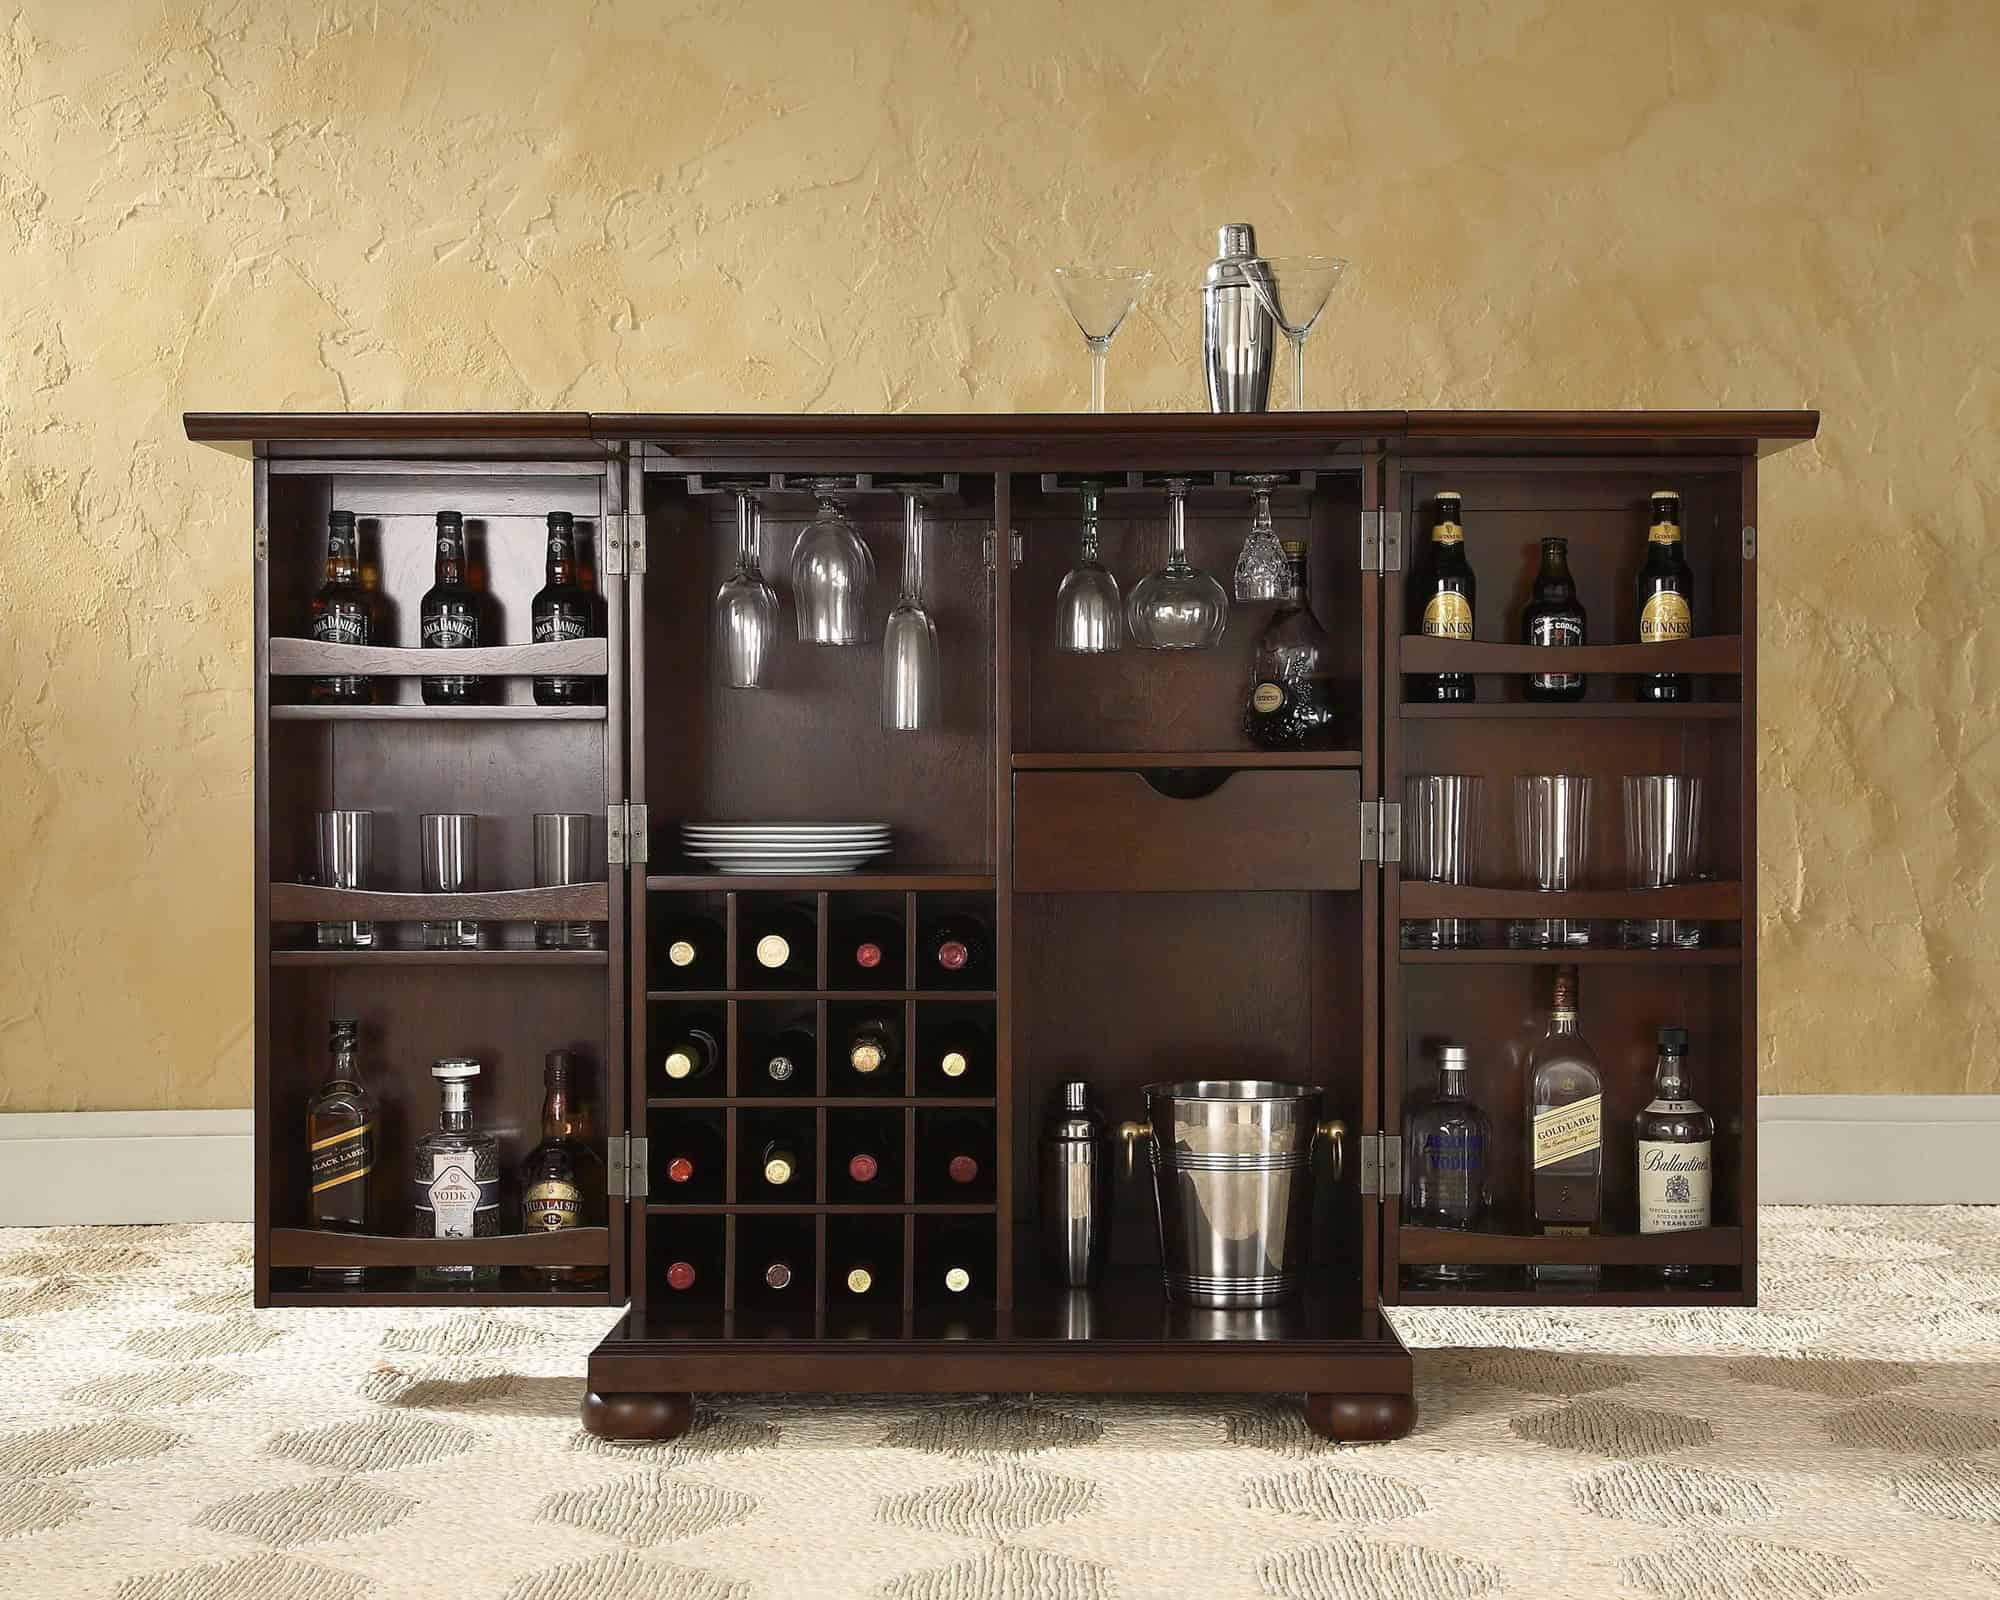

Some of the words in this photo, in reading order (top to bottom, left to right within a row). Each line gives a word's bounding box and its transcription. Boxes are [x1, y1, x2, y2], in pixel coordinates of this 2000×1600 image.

[1423, 622, 1473, 634] GUINNESS
[1641, 621, 1691, 634] GUINNESS
[1537, 1125, 1566, 1141] GOLD
[1567, 1113, 1599, 1130] LABEL
[433, 1191, 476, 1201] VODKA
